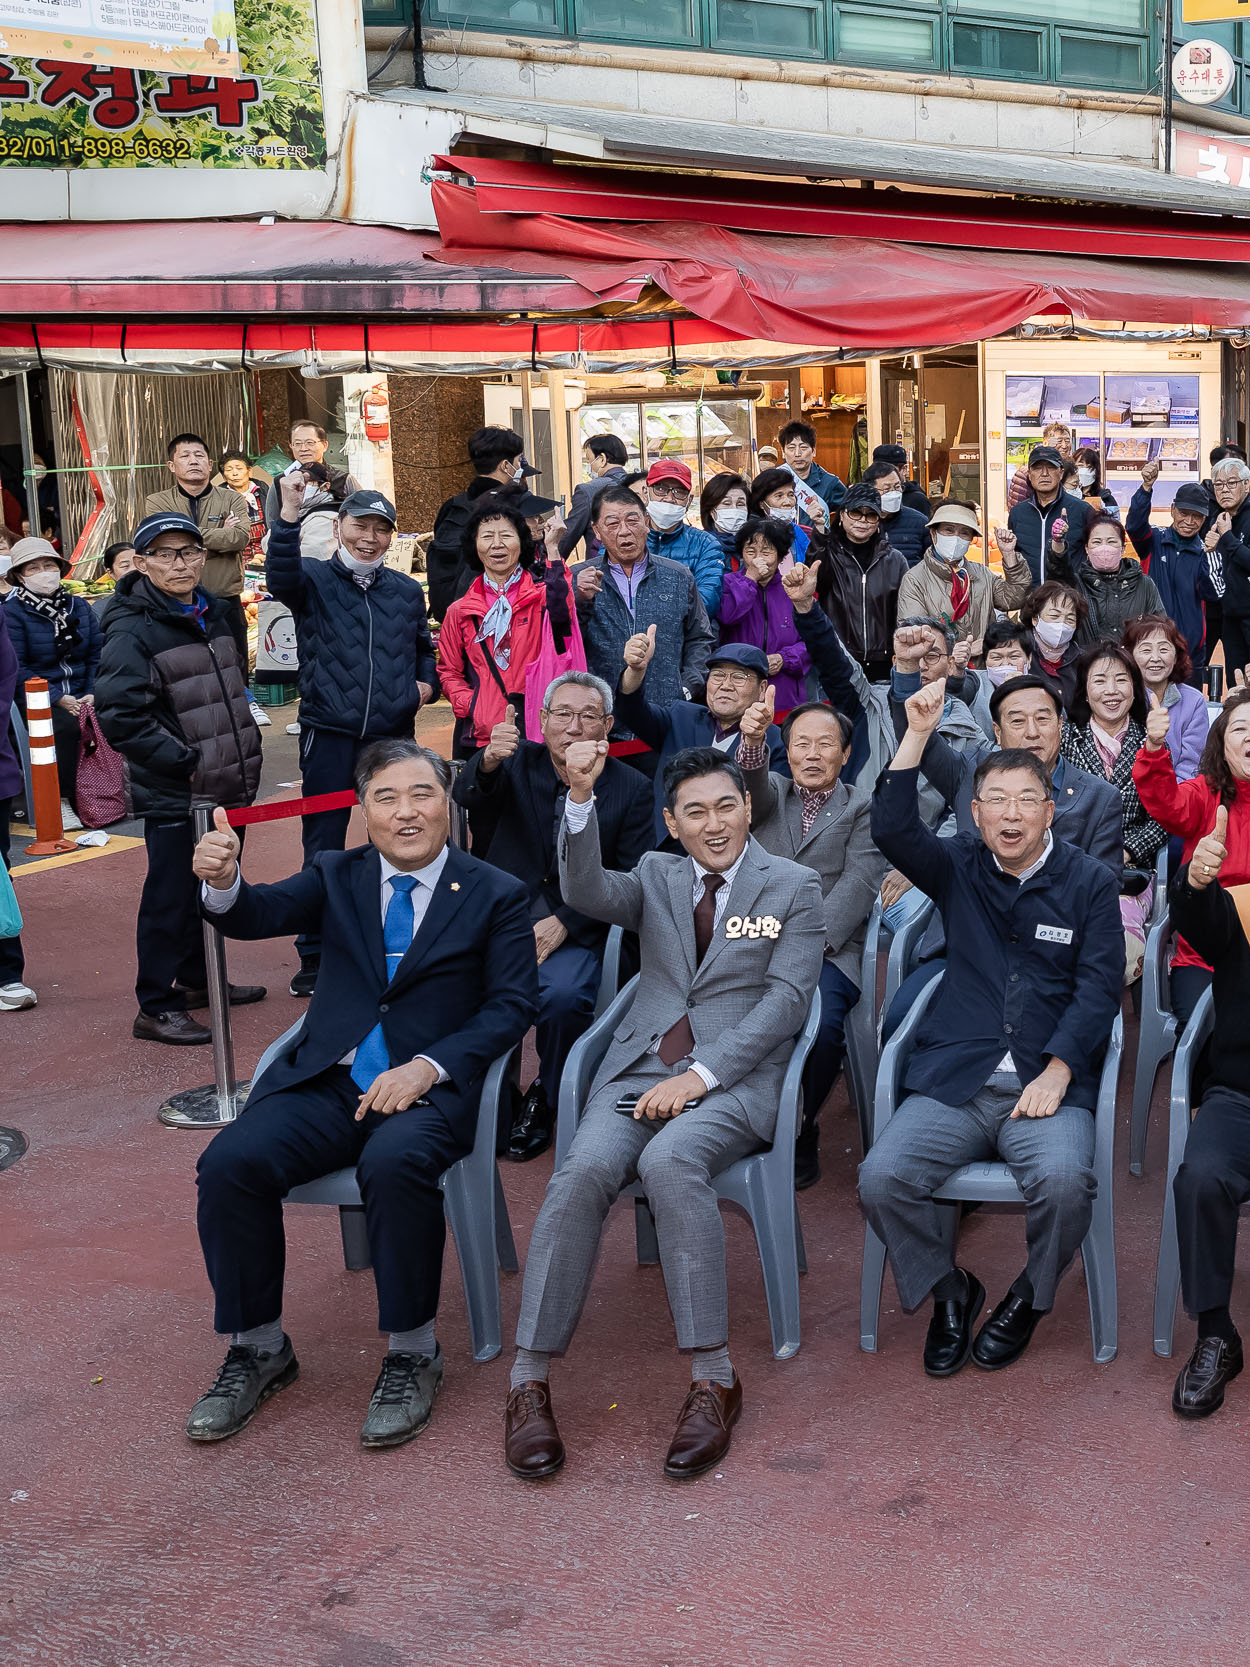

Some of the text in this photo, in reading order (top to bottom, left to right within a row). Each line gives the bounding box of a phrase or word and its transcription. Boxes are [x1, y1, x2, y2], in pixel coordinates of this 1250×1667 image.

[1176, 68, 1225, 86] 운수대통
[244, 146, 307, 158] 각종카드환영
[725, 915, 782, 939] 오신환
